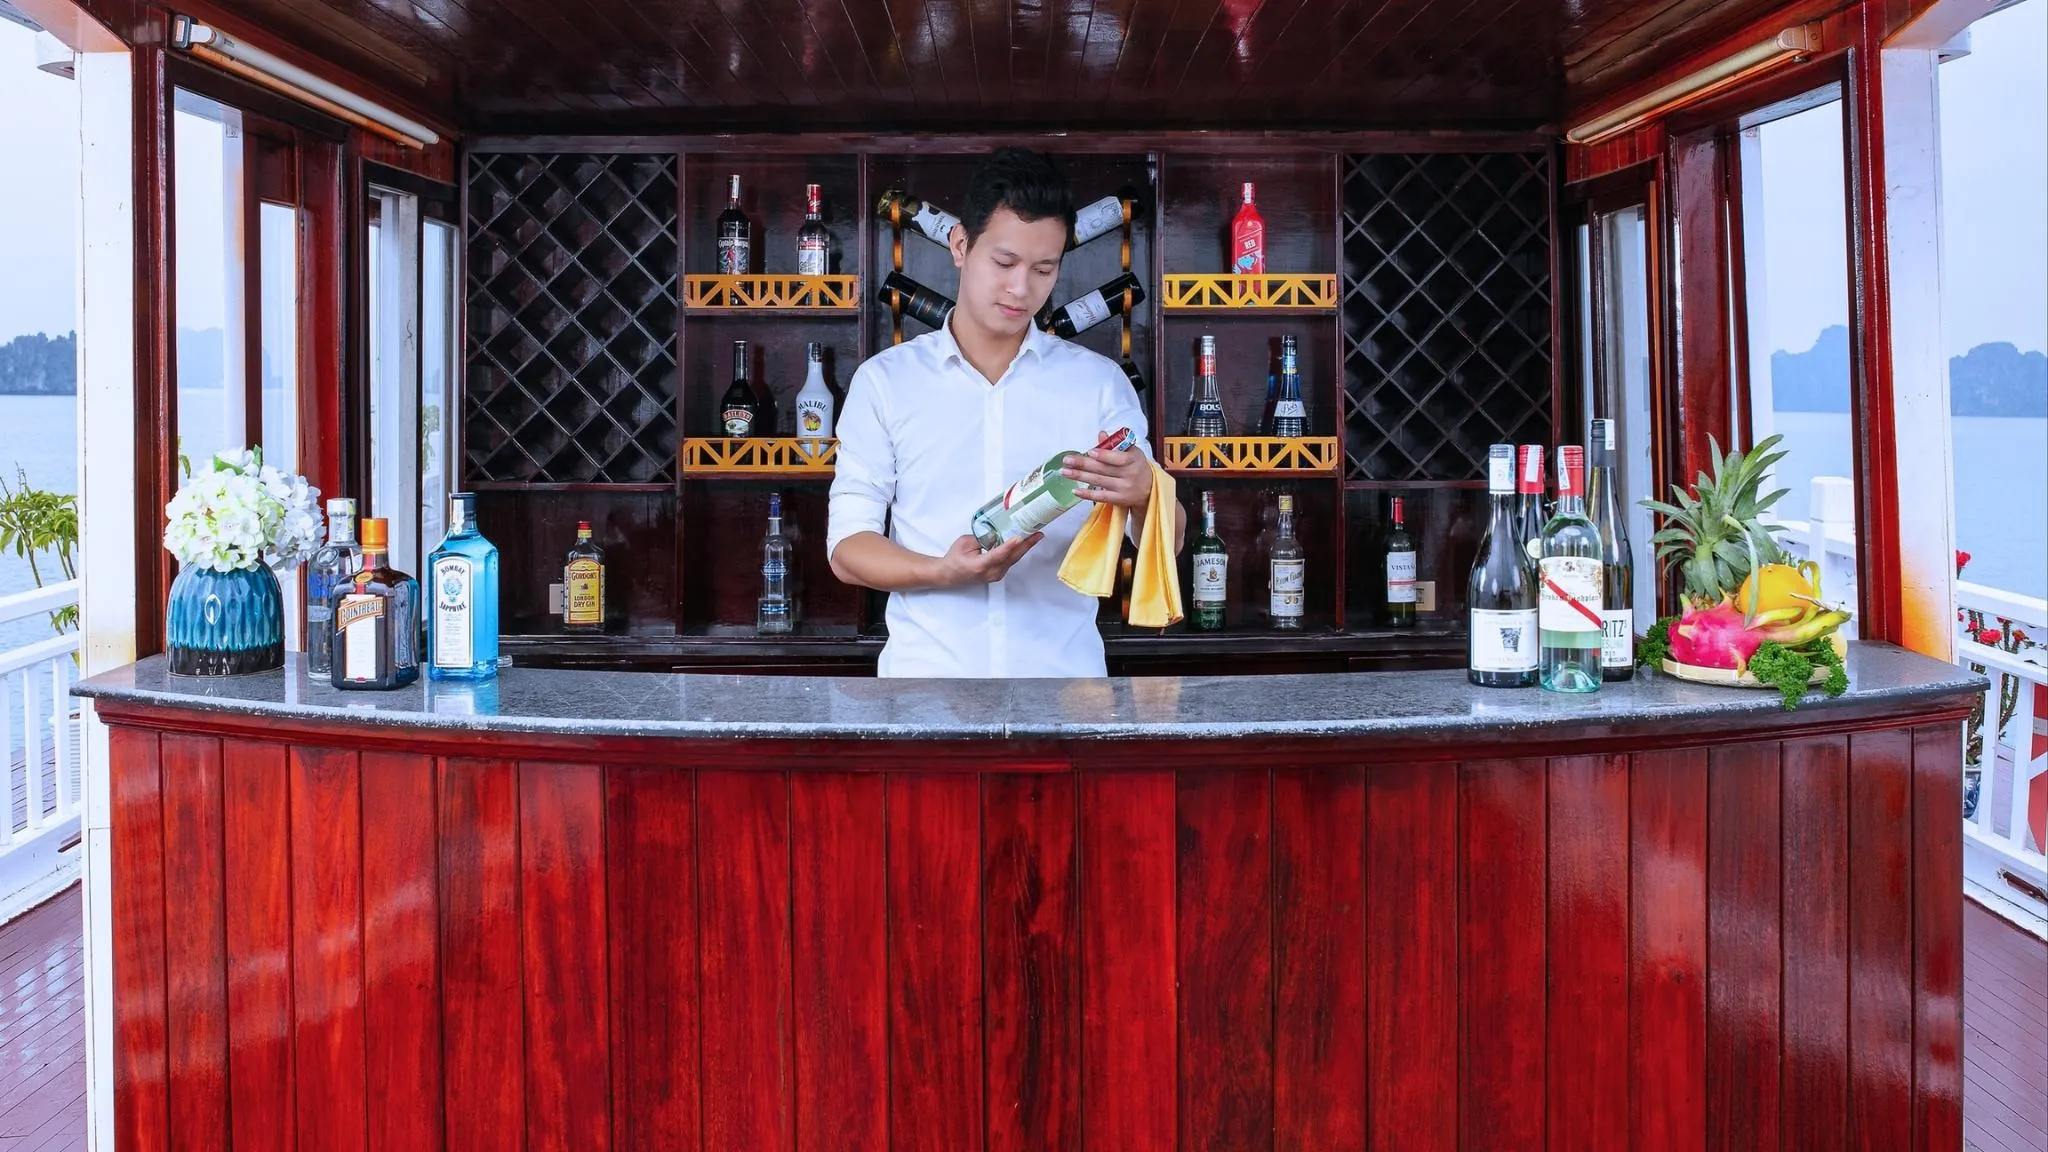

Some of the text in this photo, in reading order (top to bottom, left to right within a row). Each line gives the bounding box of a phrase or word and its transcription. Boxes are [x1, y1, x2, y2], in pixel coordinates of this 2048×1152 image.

[798, 400, 827, 412] MALIBU
[1200, 403, 1221, 411] BOLS
[723, 411, 751, 420] BAILEYS
[440, 564, 466, 576] BOMBAY
[439, 603, 467, 612] SAPPHIRE
[340, 603, 382, 624] COINTREAU
